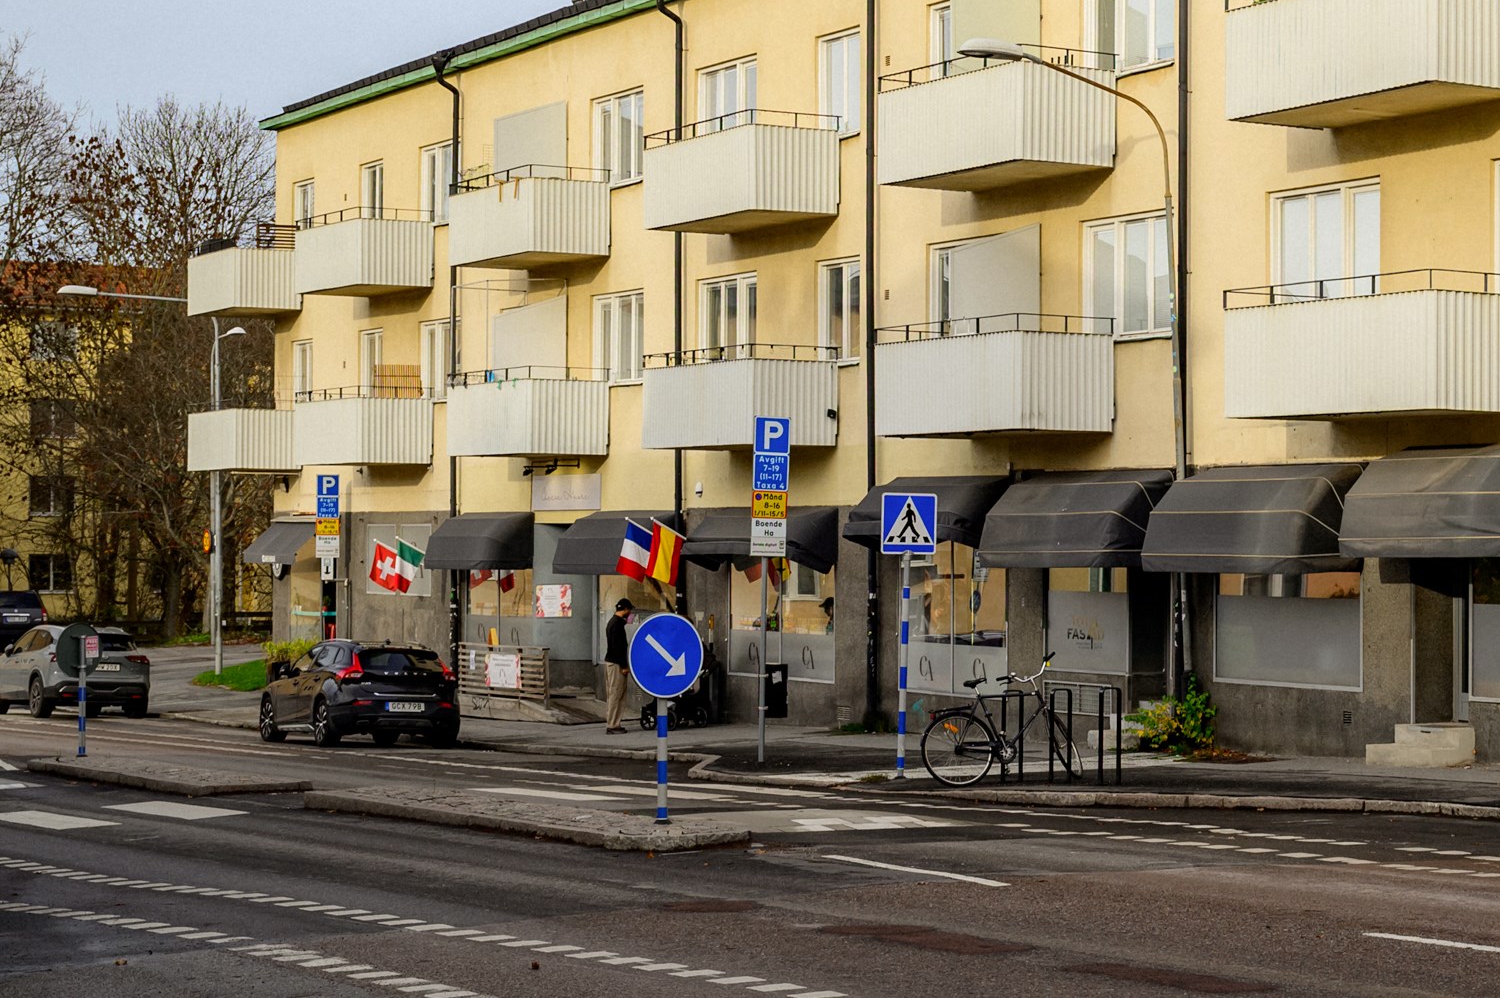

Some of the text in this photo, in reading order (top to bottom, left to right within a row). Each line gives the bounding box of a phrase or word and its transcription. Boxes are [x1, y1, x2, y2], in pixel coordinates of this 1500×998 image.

[764, 421, 783, 449] P
[758, 455, 785, 465] Avgift
[762, 464, 780, 472] 7-19
[759, 472, 783, 481] (11-17)
[322, 477, 336, 494] P
[756, 481, 777, 489] Taxa
[763, 493, 783, 501] Månd
[755, 520, 783, 528] Boende
[391, 702, 405, 710] GCX
